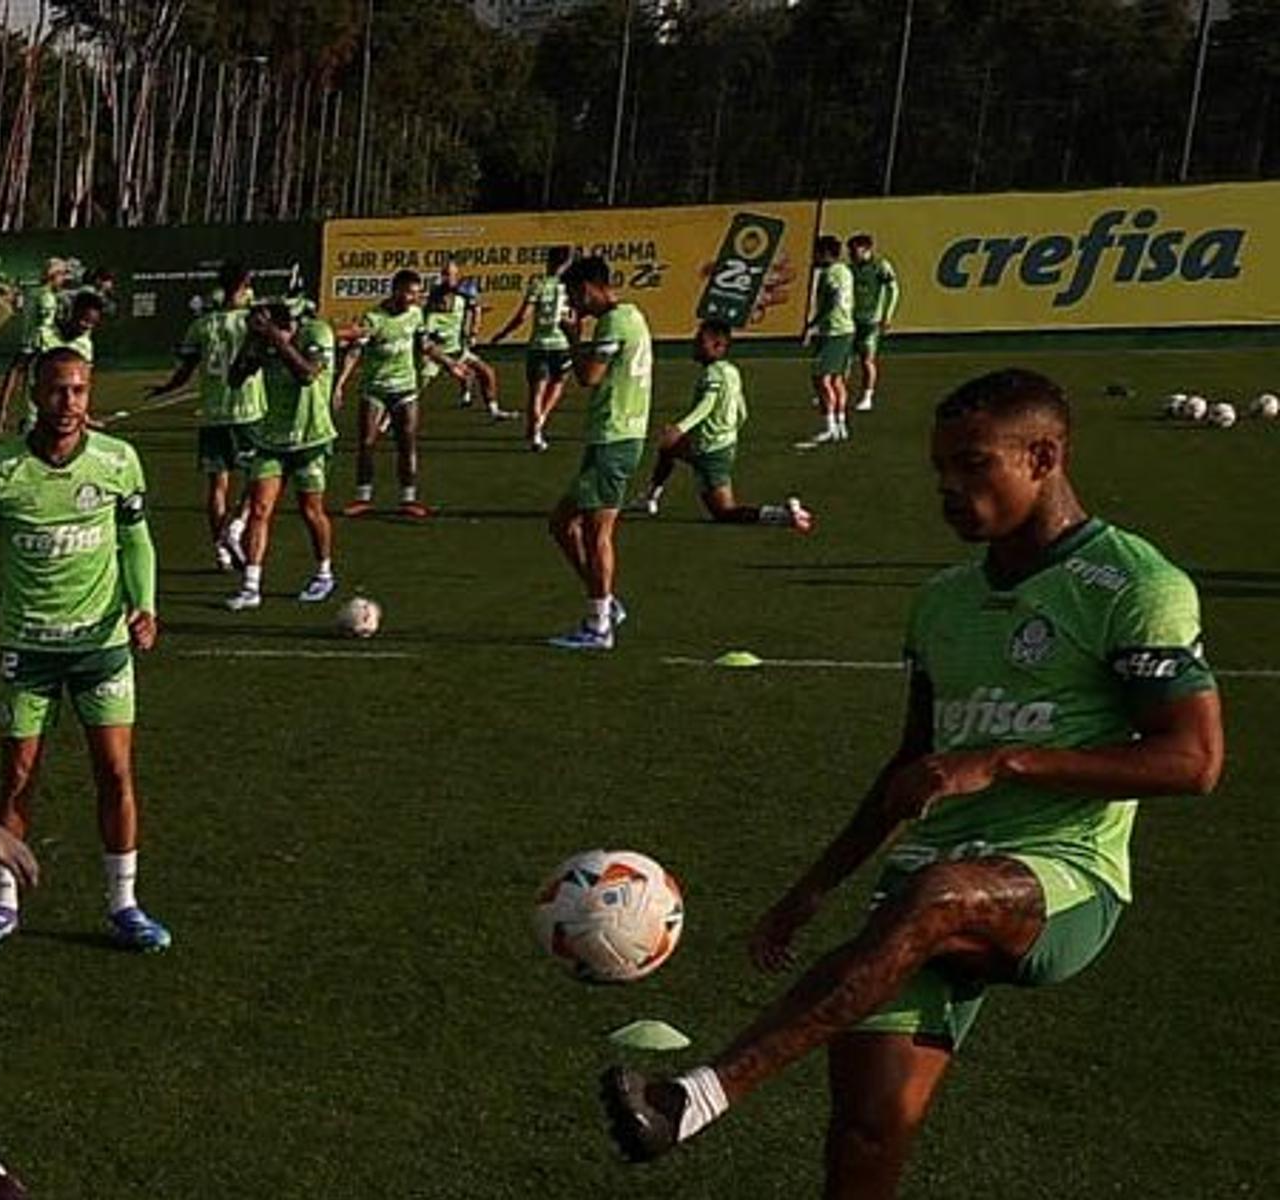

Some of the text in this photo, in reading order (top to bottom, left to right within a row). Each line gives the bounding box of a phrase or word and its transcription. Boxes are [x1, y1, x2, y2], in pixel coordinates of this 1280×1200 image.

[337, 249, 377, 269] SAIR
[382, 248, 419, 267] PRA
[423, 247, 513, 266] COMPRAR
[937, 208, 1247, 308] crefisa
